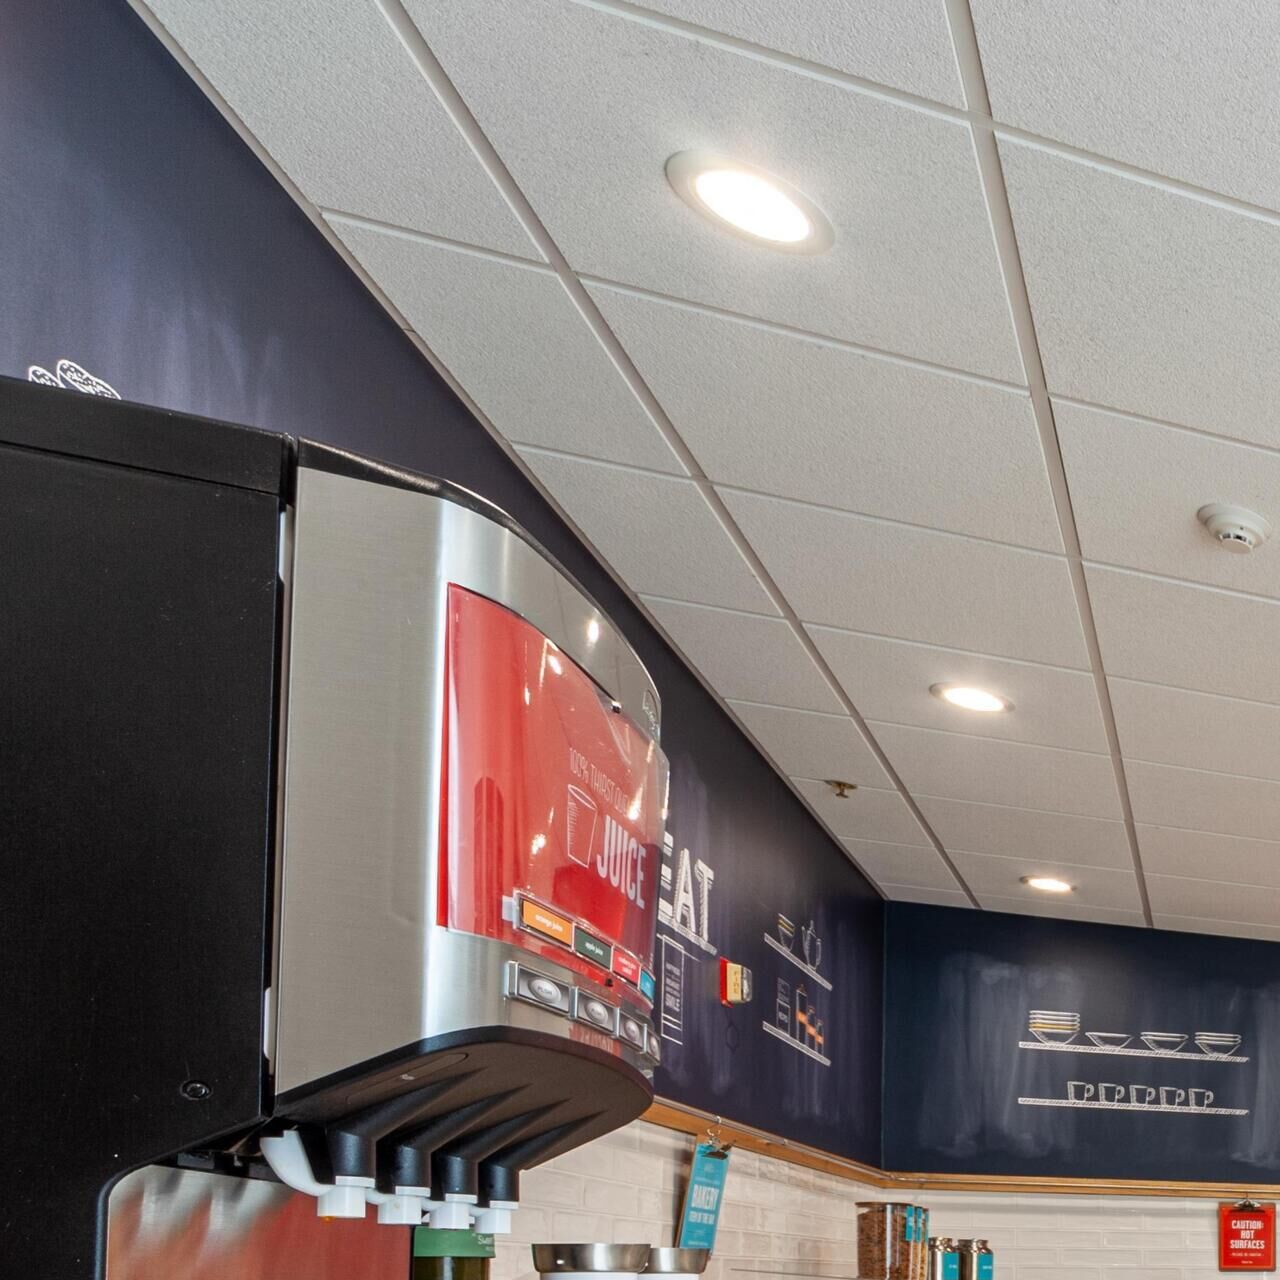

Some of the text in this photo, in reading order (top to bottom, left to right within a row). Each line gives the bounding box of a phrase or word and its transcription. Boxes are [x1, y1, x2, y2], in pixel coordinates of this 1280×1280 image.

[597, 814, 647, 909] JUICE
[1241, 1230, 1255, 1239] HOT
[1230, 1239, 1265, 1249] SURFACES
